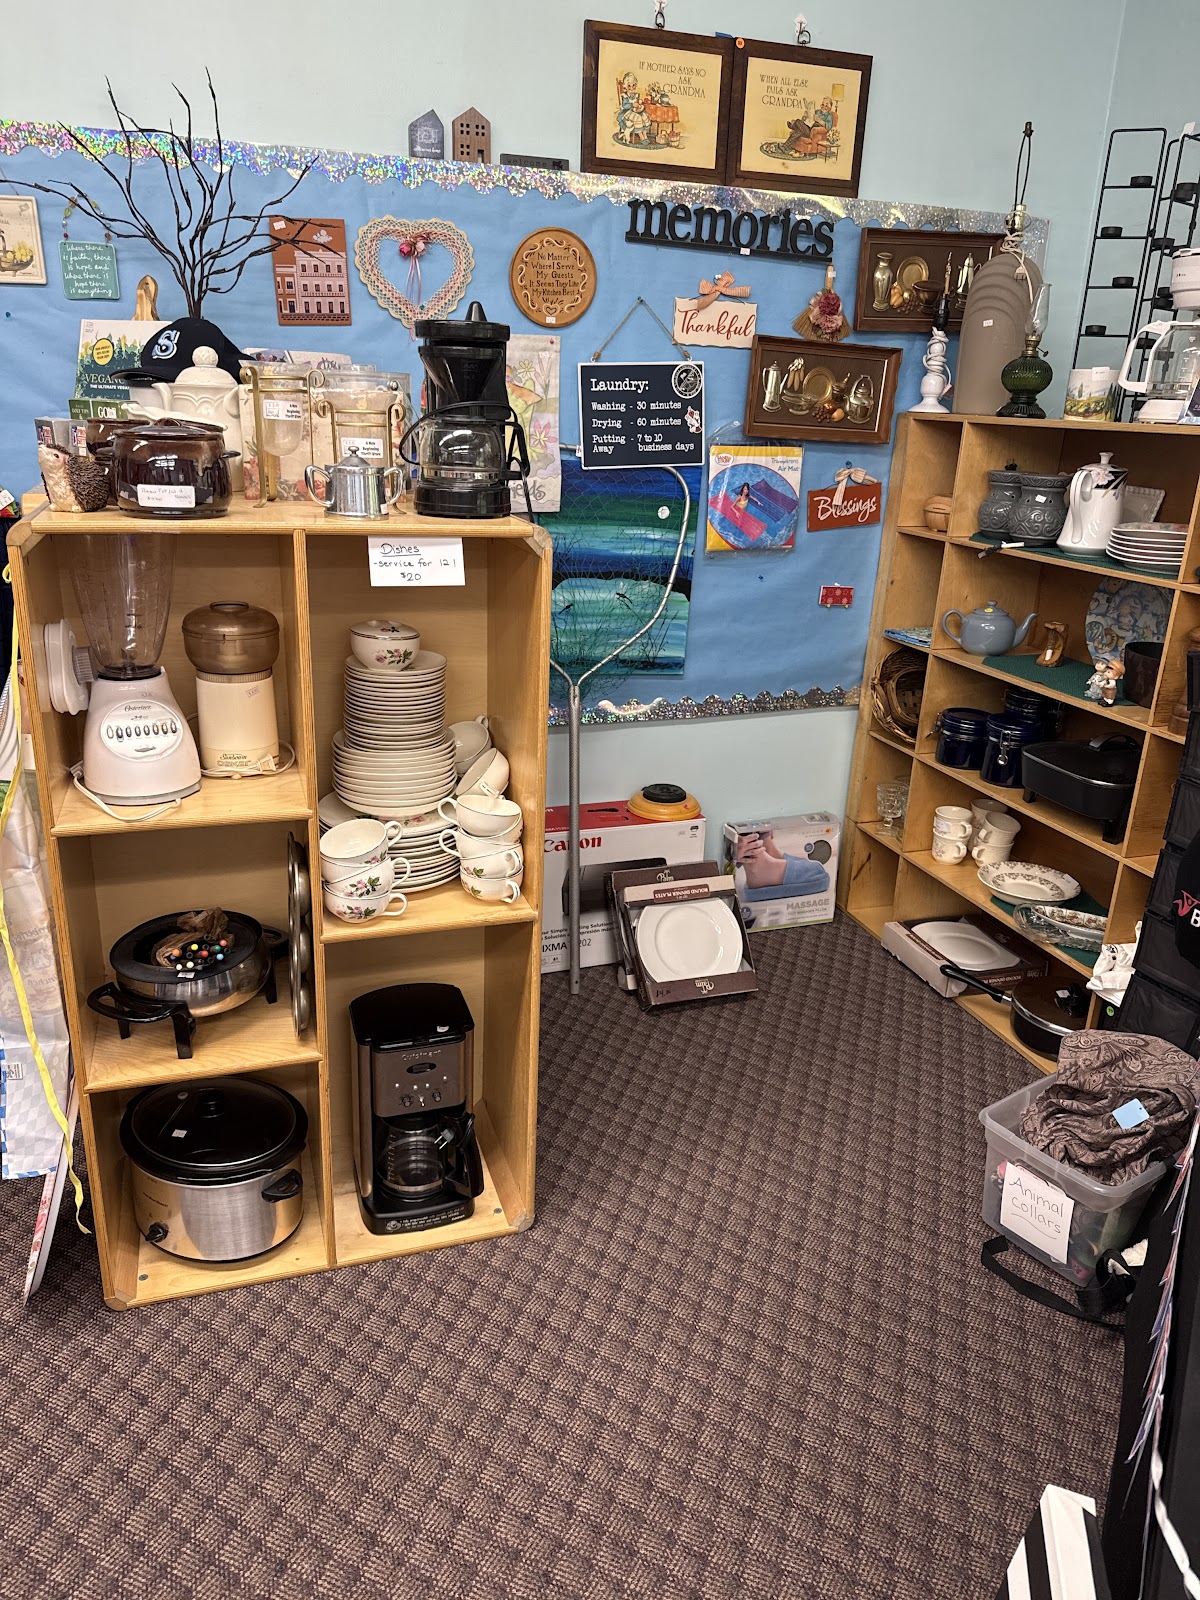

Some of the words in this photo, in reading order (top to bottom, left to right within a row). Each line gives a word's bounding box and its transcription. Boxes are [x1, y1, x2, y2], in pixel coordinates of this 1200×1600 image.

[639, 61, 646, 69] IF
[647, 63, 676, 74] MOTHER
[678, 66, 694, 76] SAYS
[695, 68, 707, 77] NO
[678, 76, 692, 85] ASK
[760, 74, 778, 84] WHEN
[781, 77, 791, 86] ALL
[794, 78, 809, 88] ELSE
[663, 83, 706, 98] GRANDMA
[767, 86, 783, 95] FAILS
[786, 88, 798, 97] ASK
[762, 95, 803, 109] GRANDPA
[506, 156, 548, 168] welcome
[626, 199, 834, 257] memories
[537, 252, 546, 261] No
[547, 252, 570, 260] Matter
[531, 262, 551, 270] Where
[556, 262, 575, 270] Serve
[536, 271, 548, 280] My
[551, 271, 574, 279] Guests
[536, 280, 555, 288] Seems
[556, 280, 569, 289] They
[678, 308, 756, 340] Thankful
[590, 378, 649, 394] Laundry:
[591, 402, 626, 412] Washing
[636, 401, 647, 410] 30
[650, 401, 682, 410] minutes
[592, 419, 622, 429] Drying
[637, 418, 647, 427] 60
[650, 418, 682, 426] minutes
[592, 435, 626, 445] Putting
[637, 434, 642, 443] 7
[644, 434, 653, 443] to
[654, 434, 663, 442] 10
[593, 445, 614, 455] Away
[638, 443, 672, 452] business
[675, 442, 695, 453] days
[380, 543, 420, 554] Dishes
[417, 558, 432, 568] for
[400, 572, 422, 582] $20
[543, 836, 602, 853] Caon
[786, 899, 830, 910] MASSAGE
[542, 942, 568, 953] IXMA
[1008, 1177, 1064, 1218] Animal
[1011, 1197, 1061, 1234] Collars
